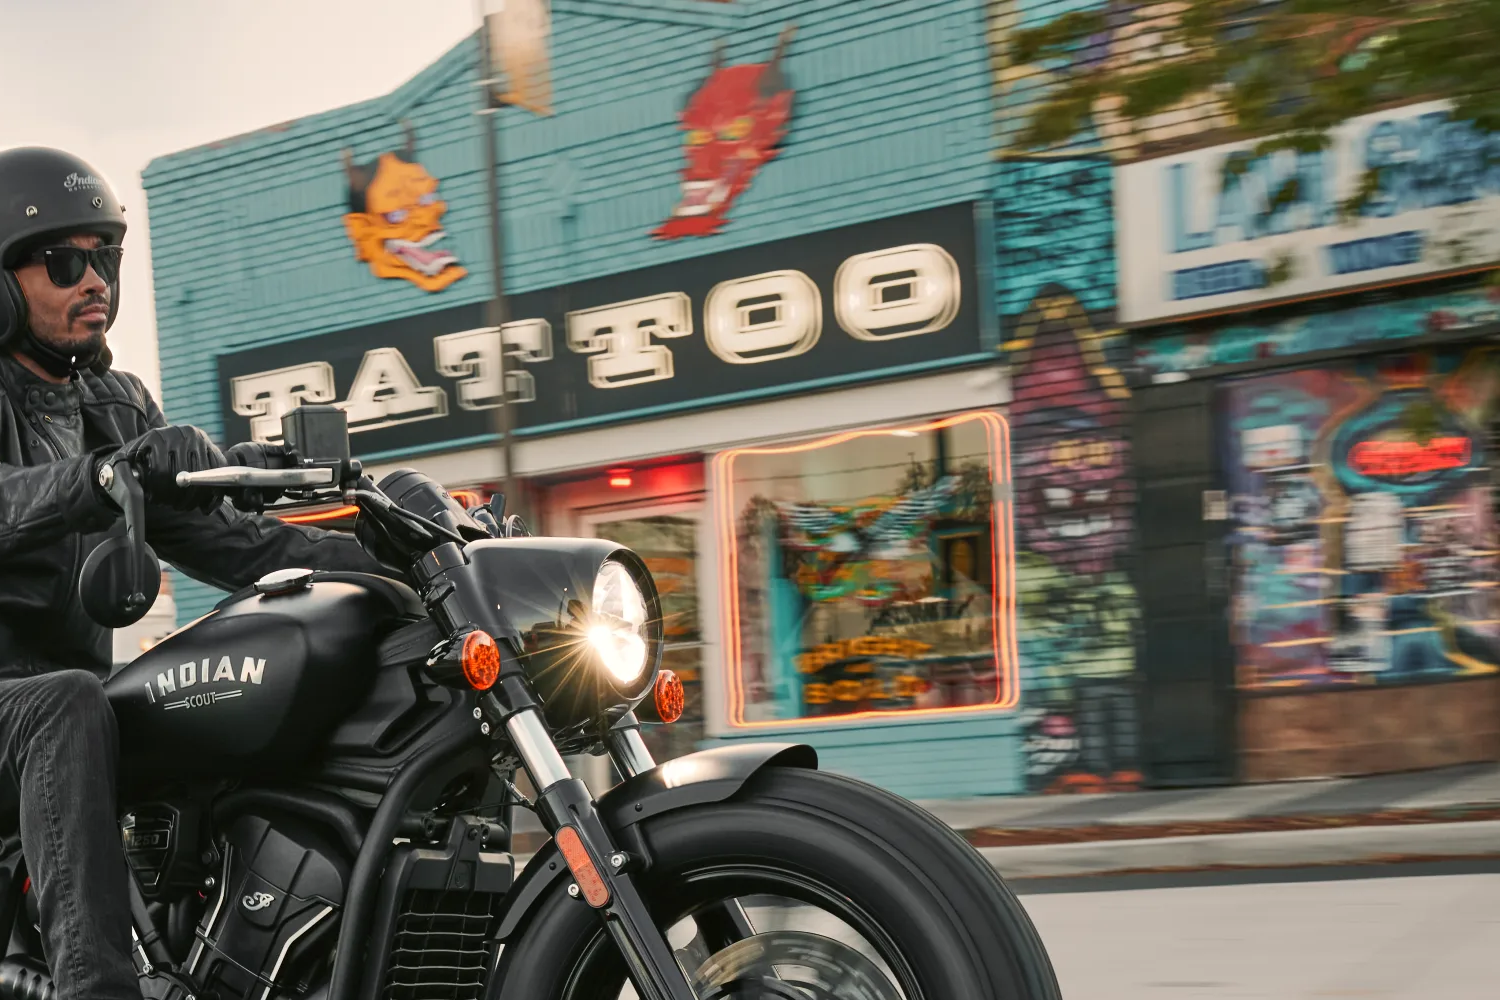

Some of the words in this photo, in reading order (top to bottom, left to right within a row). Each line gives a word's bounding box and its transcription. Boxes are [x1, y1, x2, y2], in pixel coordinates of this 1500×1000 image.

[230, 243, 961, 447] TATTOO
[144, 655, 266, 704] INDIAN
[184, 691, 216, 709] SCOUT
[131, 834, 159, 847] 1250
